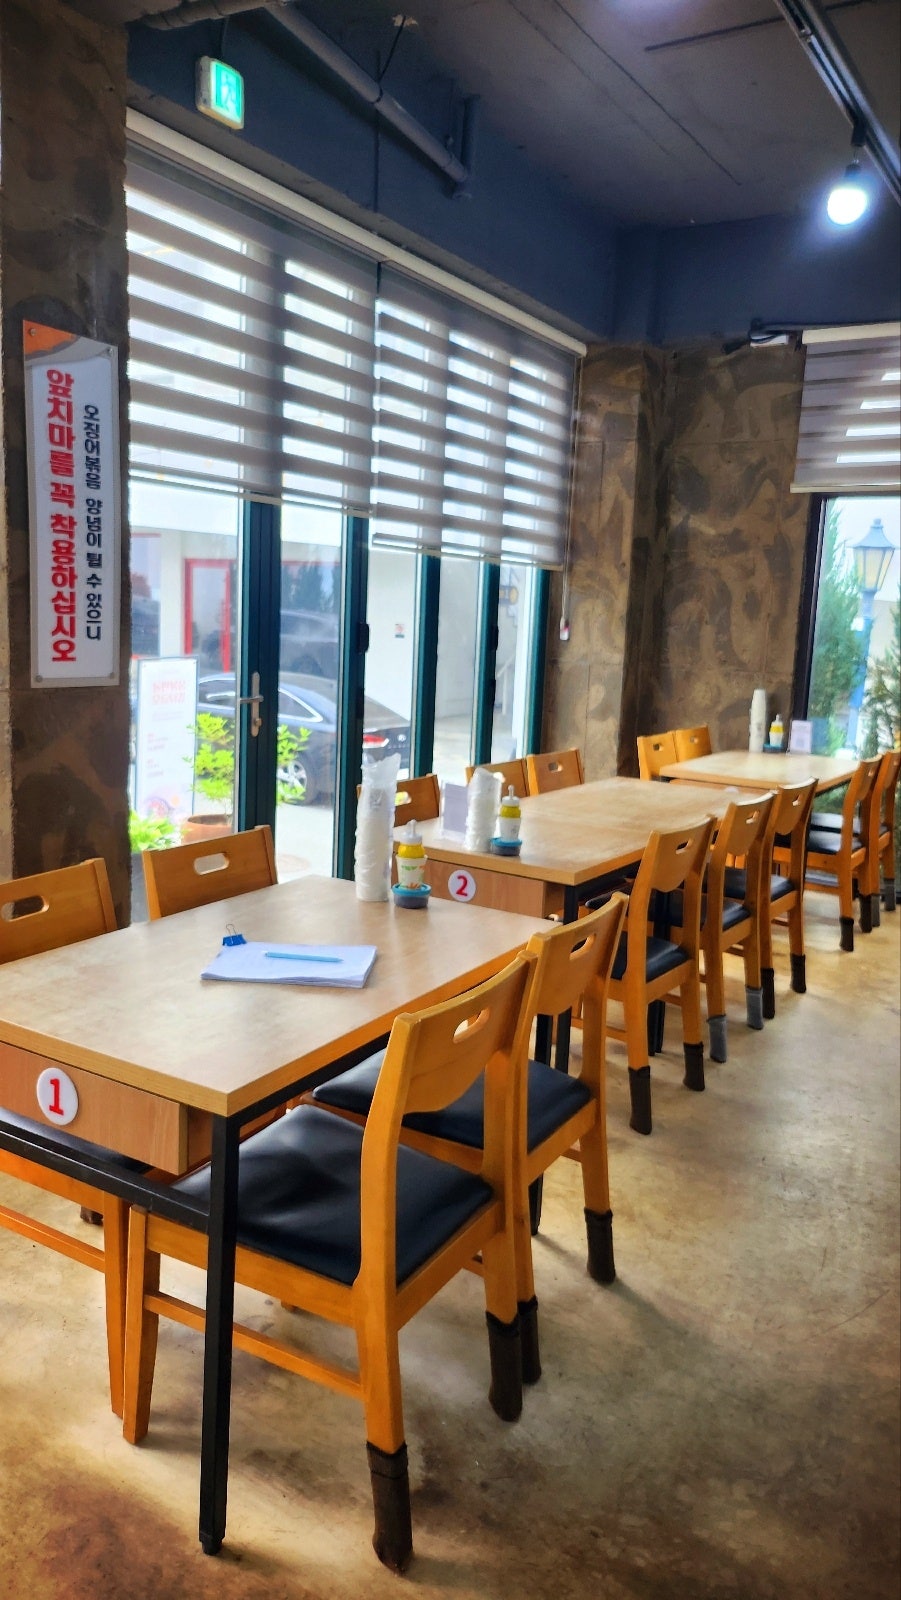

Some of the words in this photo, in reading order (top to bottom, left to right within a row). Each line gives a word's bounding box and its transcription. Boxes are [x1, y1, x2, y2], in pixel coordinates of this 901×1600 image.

[46, 368, 76, 477] 앞치마를
[83, 404, 102, 490] 오징어볶음
[50, 482, 76, 508] 꼭
[85, 498, 103, 548] 양념이
[50, 514, 77, 662] 착용하십시오
[86, 573, 103, 589] 수
[86, 593, 103, 641] 있으니
[456, 875, 468, 897] 2
[49, 1079, 64, 1115] 1
